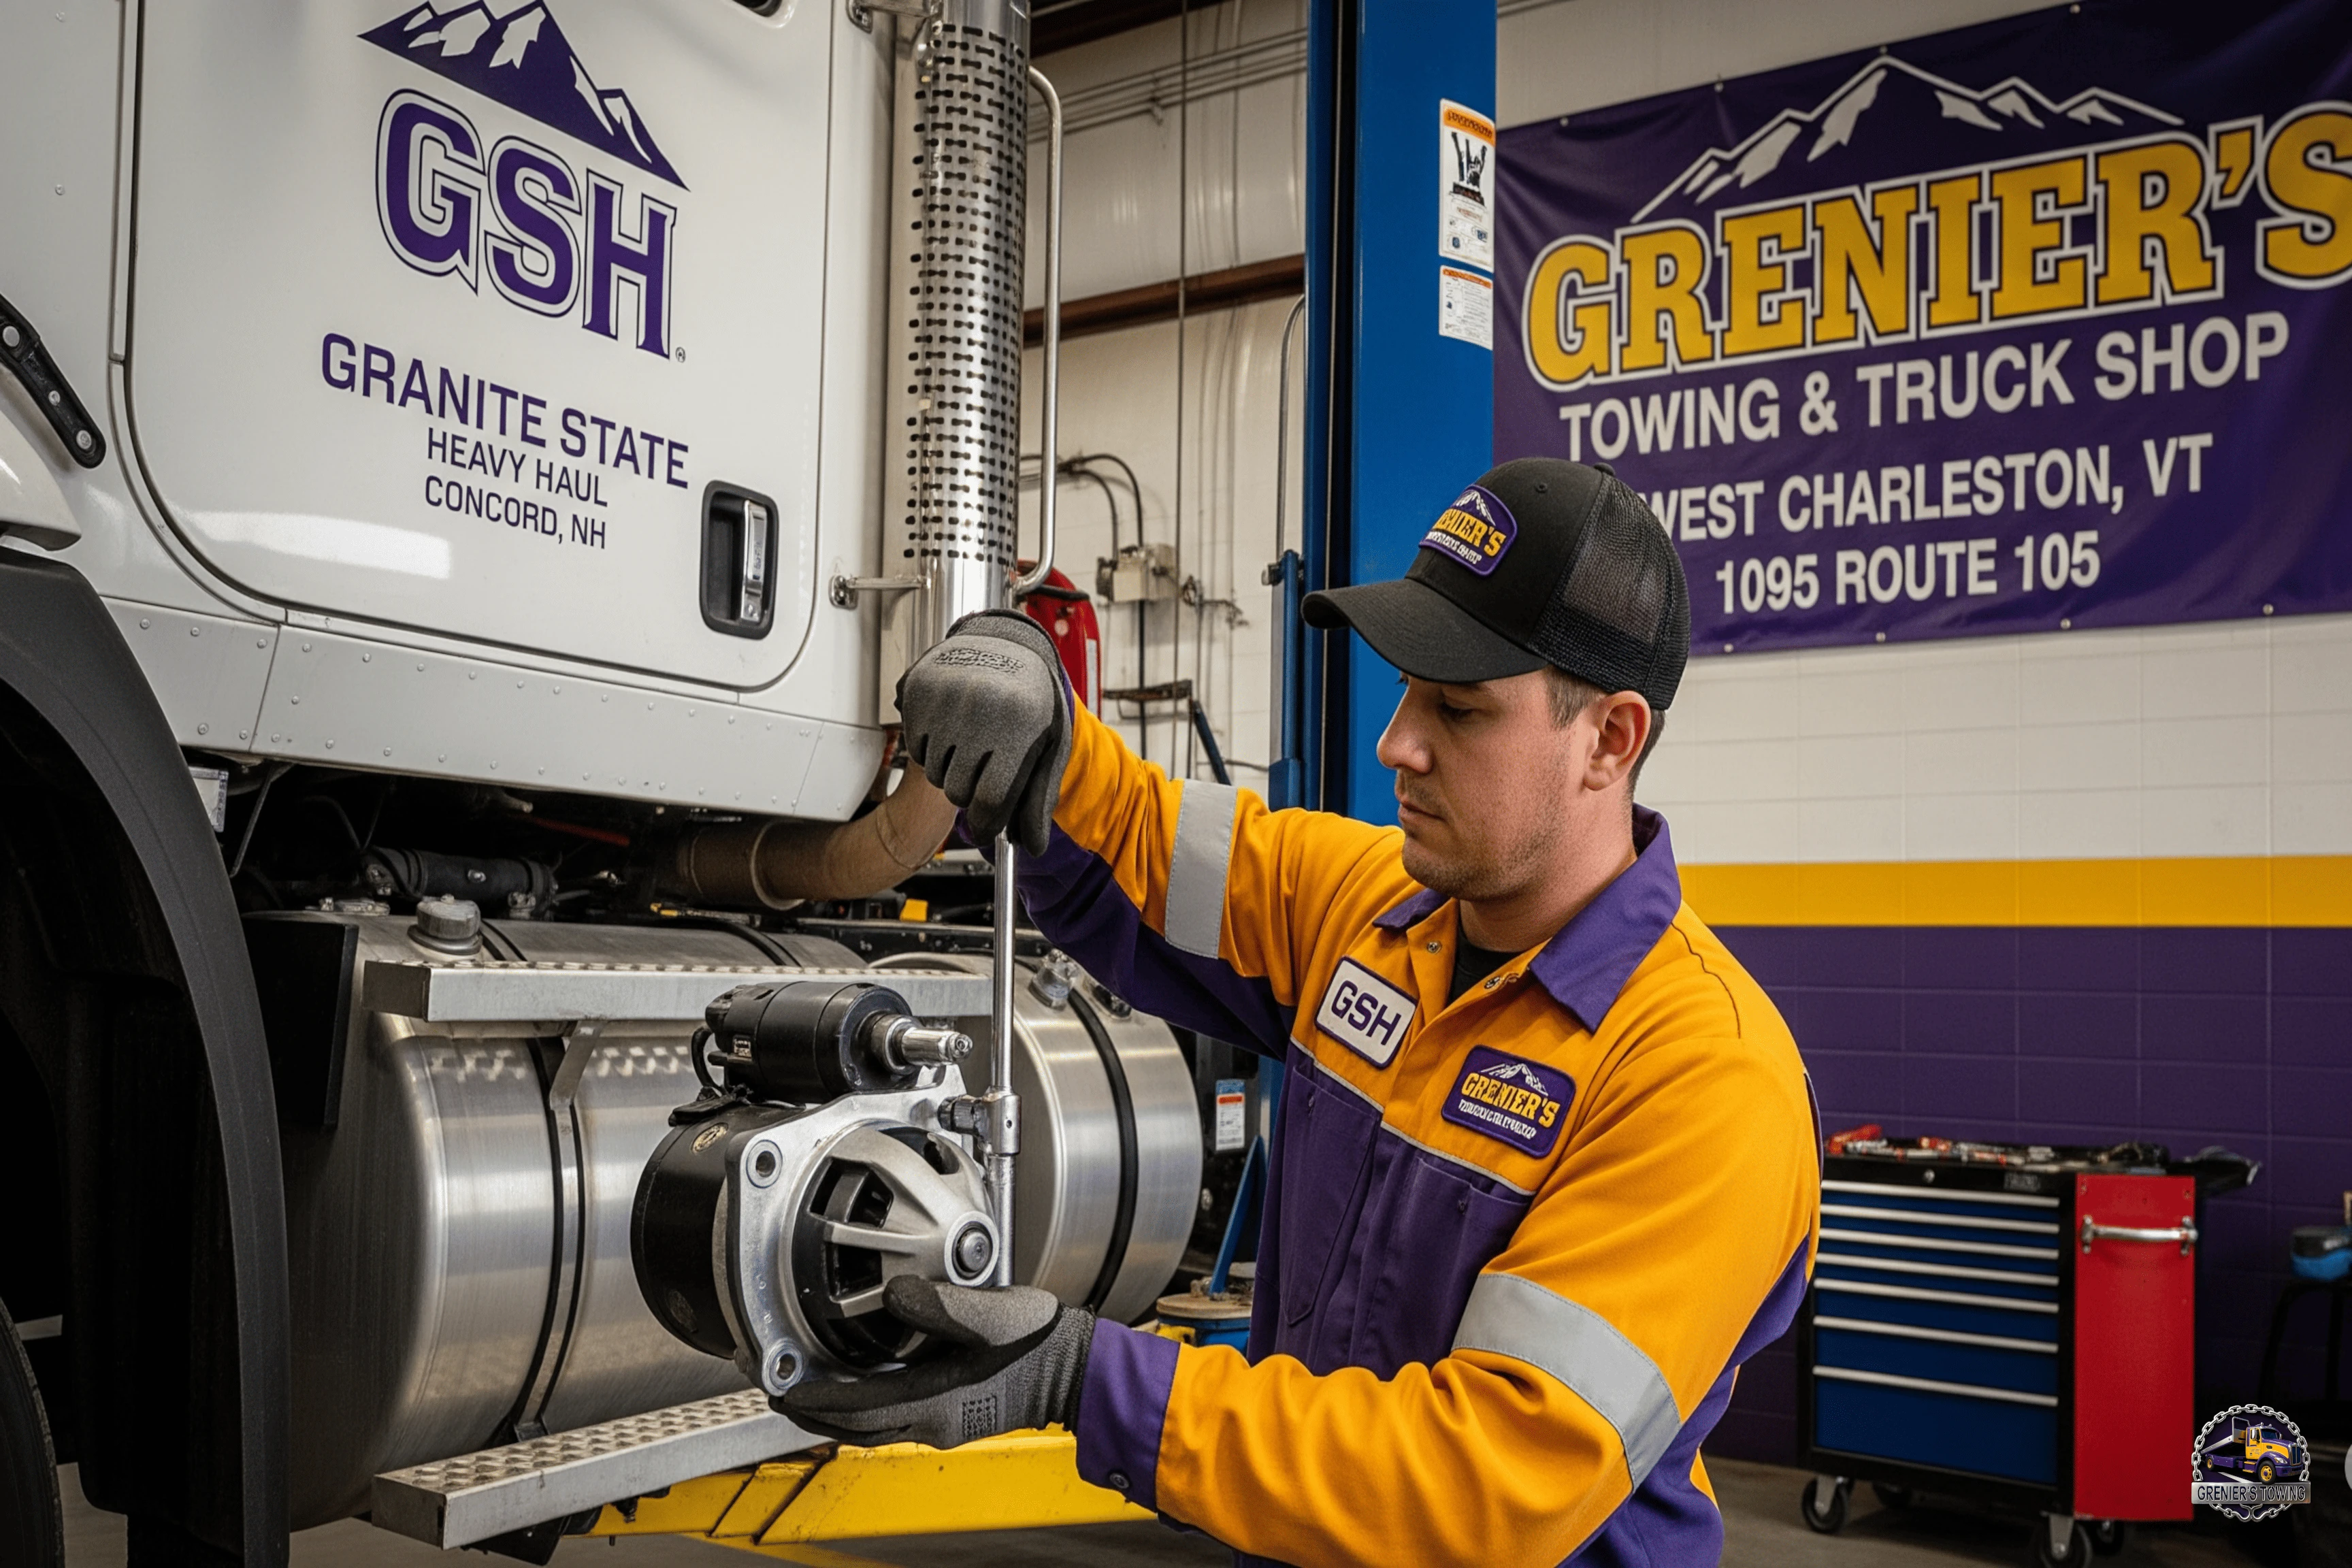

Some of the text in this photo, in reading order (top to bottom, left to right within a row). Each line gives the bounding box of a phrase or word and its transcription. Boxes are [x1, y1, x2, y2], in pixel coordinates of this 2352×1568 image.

[376, 88, 677, 360] GSH
[1522, 99, 2352, 392] GRENIER'S
[322, 333, 689, 489] GRANITE STATE
[1559, 310, 2289, 462] TOWING & TRUCK SHOP
[425, 475, 606, 549] CONCORD, NH
[427, 427, 608, 508] HEAVY HAUL
[1778, 444, 2124, 533] CHARLESTON,
[2143, 432, 2213, 497] VT
[1716, 529, 2101, 615] 1095 ROUTE 105
[1330, 980, 1401, 1046] GSH
[1461, 1073, 1561, 1128] GRENIER'S
